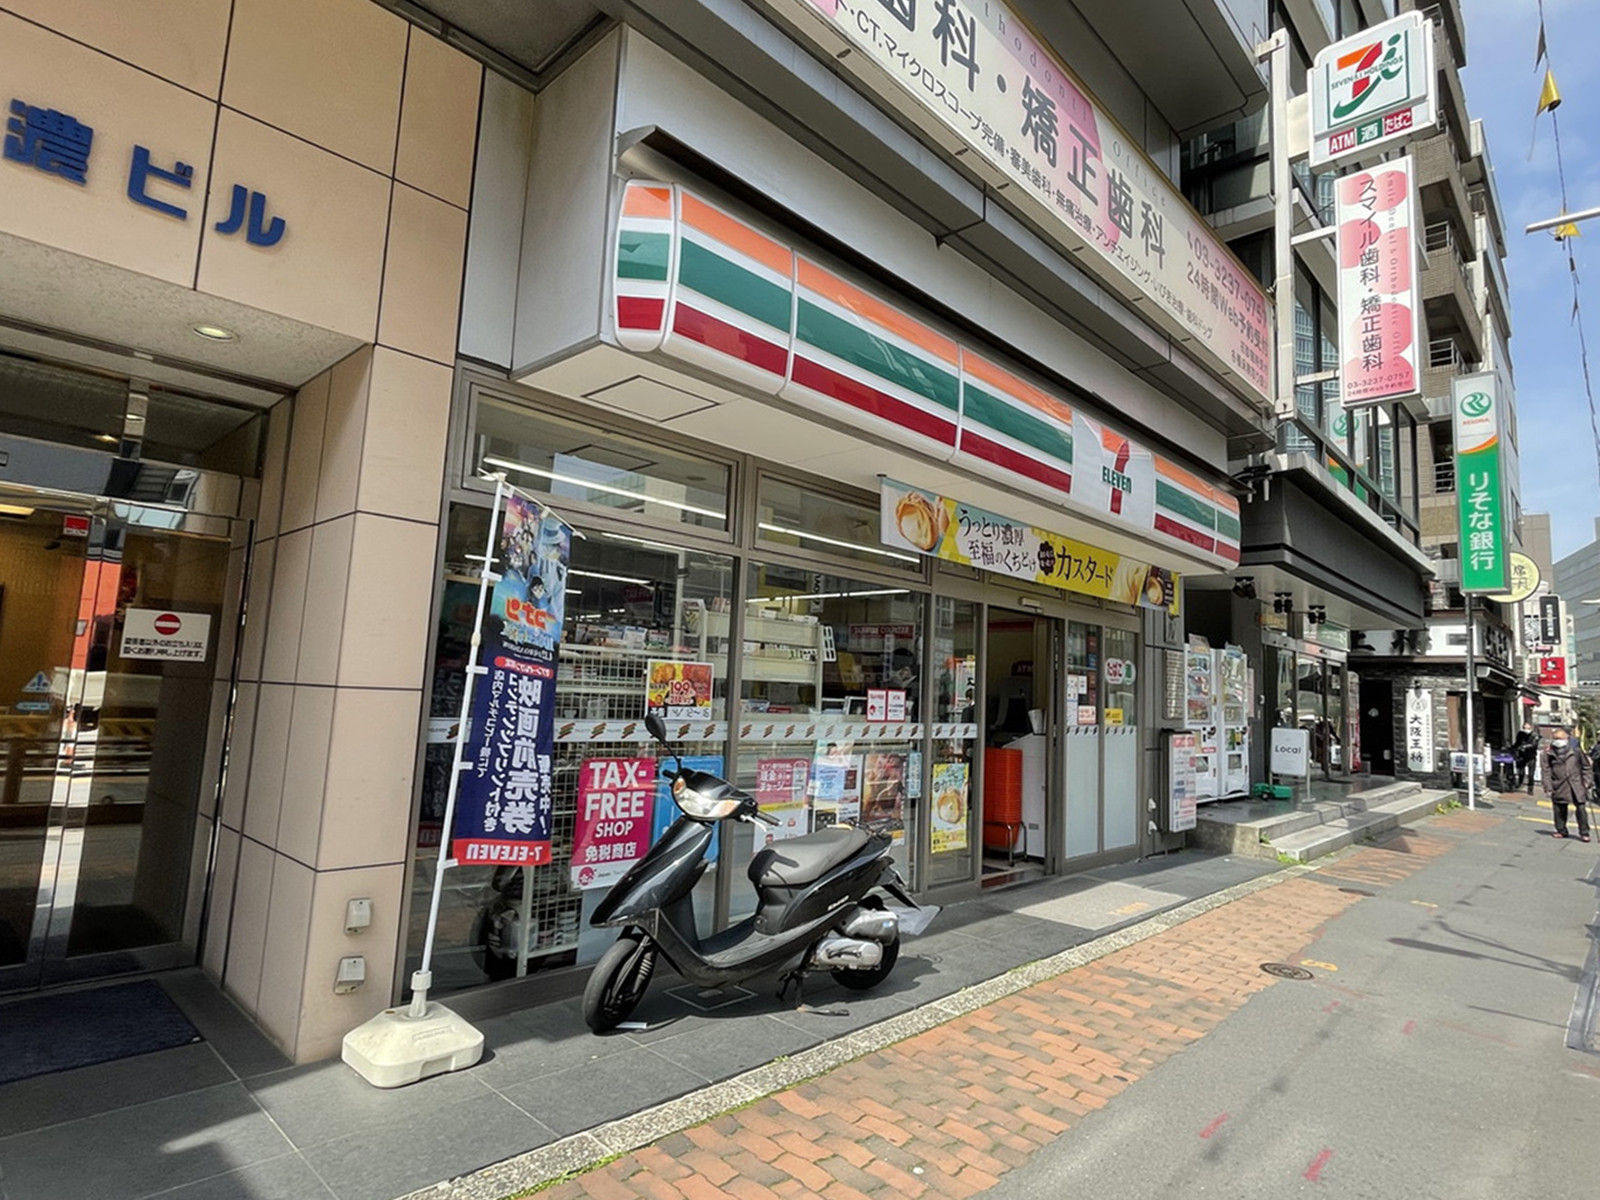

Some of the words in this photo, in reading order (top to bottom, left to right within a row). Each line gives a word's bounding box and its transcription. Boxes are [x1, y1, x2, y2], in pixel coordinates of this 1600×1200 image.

[1363, 55, 1404, 77] HOLDINGS
[1330, 129, 1356, 155] ATM
[1361, 122, 1379, 143] 酒
[1384, 111, 1413, 136] たばこ
[1358, 178, 1385, 373] スマイル歯科・矯正歯科
[958, 508, 1025, 547] うっとり濃厚
[1467, 471, 1495, 572] りそな銀行
[968, 538, 1037, 573] 至福のくちどけ
[1056, 545, 1113, 589] カスタード
[1275, 745, 1302, 754] Local
[589, 760, 648, 790] TAX-
[584, 790, 646, 821] FREE
[594, 820, 635, 838] SHOP
